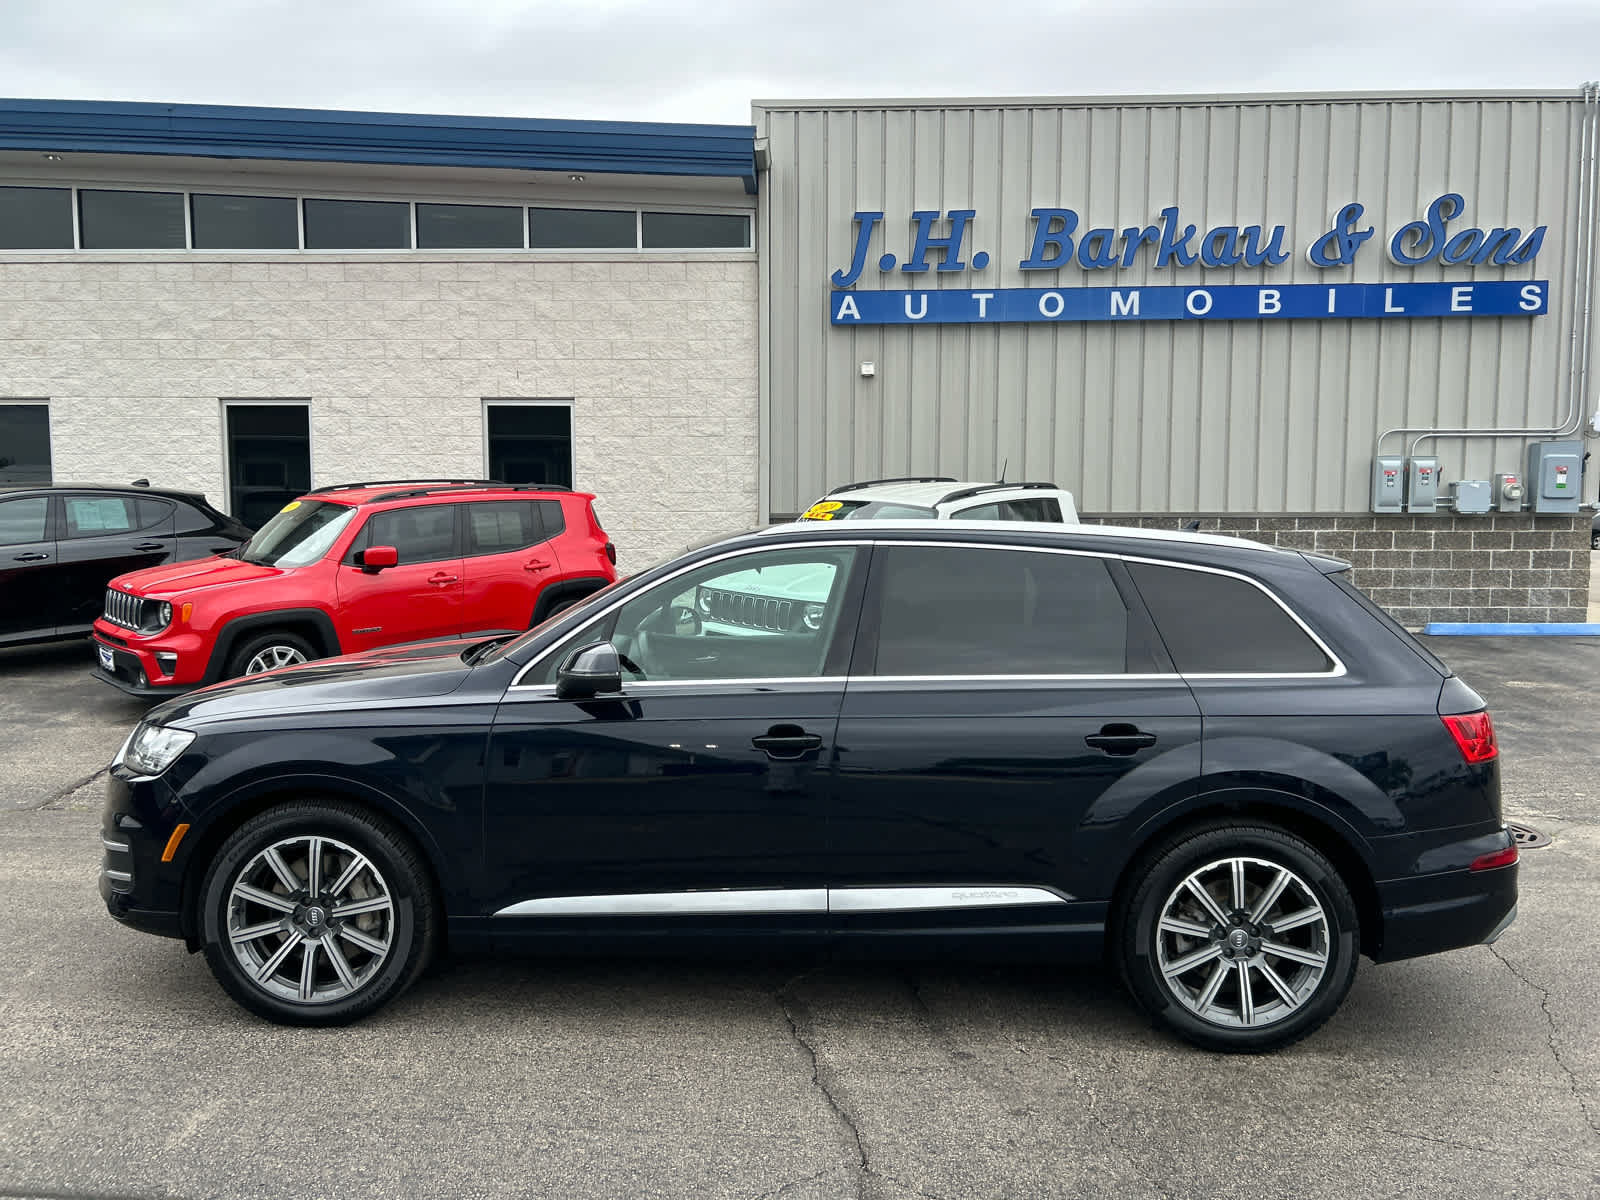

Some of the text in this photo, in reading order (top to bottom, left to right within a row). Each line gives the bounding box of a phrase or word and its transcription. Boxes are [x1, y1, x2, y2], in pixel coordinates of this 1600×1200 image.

[831, 193, 1548, 287] J.H. Barkau & Sons
[836, 284, 1542, 320] AUTOMOBILES
